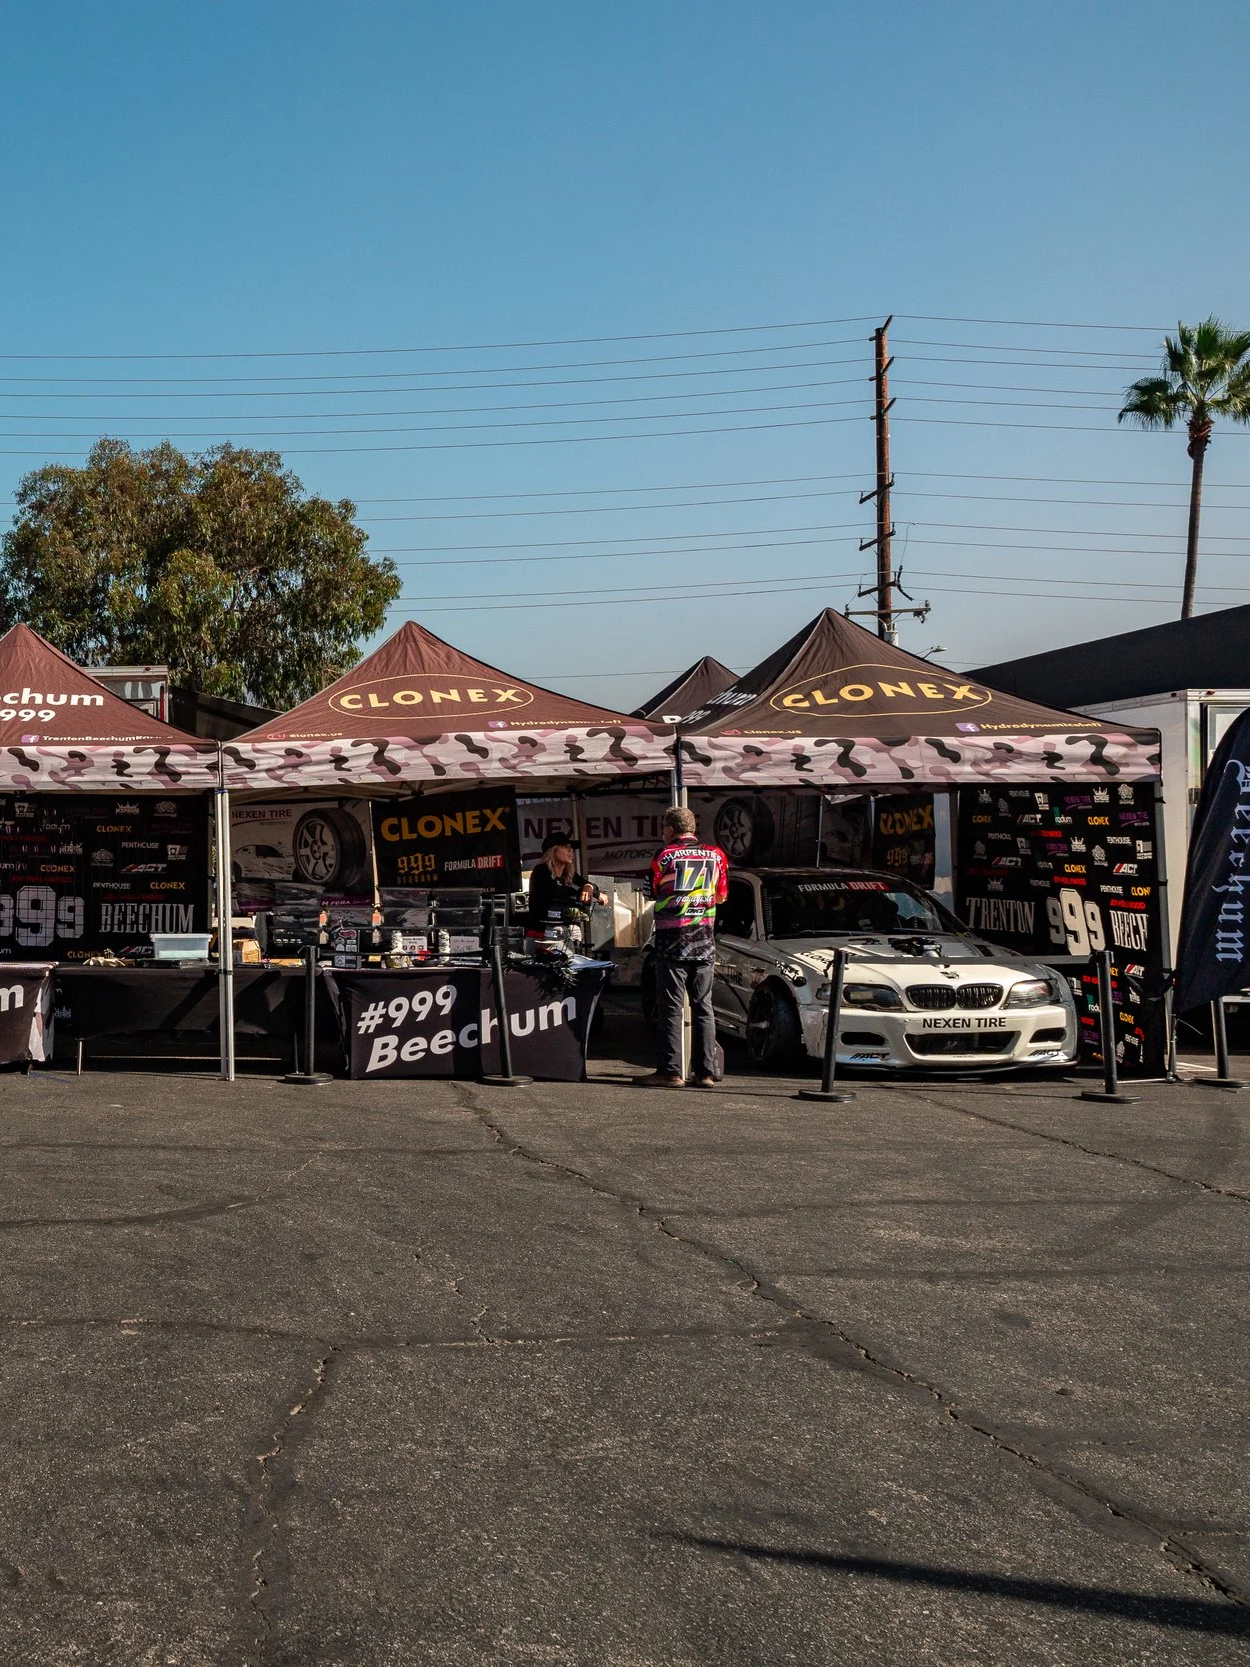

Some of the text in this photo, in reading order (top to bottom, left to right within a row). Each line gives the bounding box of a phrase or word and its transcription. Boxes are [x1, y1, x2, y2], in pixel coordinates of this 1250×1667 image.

[339, 688, 524, 710] CLONEX
[782, 681, 983, 707] CLONEX
[232, 809, 292, 819] NEXEN TIRE
[1022, 813, 1042, 823] ACT
[381, 807, 507, 842] CLONEX
[879, 804, 934, 836] CLONEX
[1087, 816, 1110, 826] CLONEX
[96, 825, 132, 833] CLONEX
[121, 841, 160, 849] PENTHOUSE
[1106, 836, 1132, 845] PENTHOUSE
[661, 849, 722, 865] CHARPENTIER
[999, 856, 1022, 866] ACT
[39, 864, 75, 873] CLONEX
[444, 855, 502, 872] FORMULA DRIFT
[1064, 863, 1087, 874] CLONEX
[1118, 863, 1138, 874] ACT
[674, 858, 717, 891] 171
[92, 882, 132, 890] PENTHOUSE
[149, 881, 186, 890] CLONEX
[797, 881, 886, 892] FORMULA DRIFT
[1100, 885, 1124, 894] PENTHOUSE
[99, 903, 195, 933] BEECHUM
[966, 897, 1036, 935] TRENTON
[1046, 888, 1106, 956] 999
[356, 984, 458, 1035] #999
[922, 1017, 1007, 1029] NEXEN TIRE
[365, 996, 578, 1073] Beechum
[857, 1052, 890, 1060] ACT
